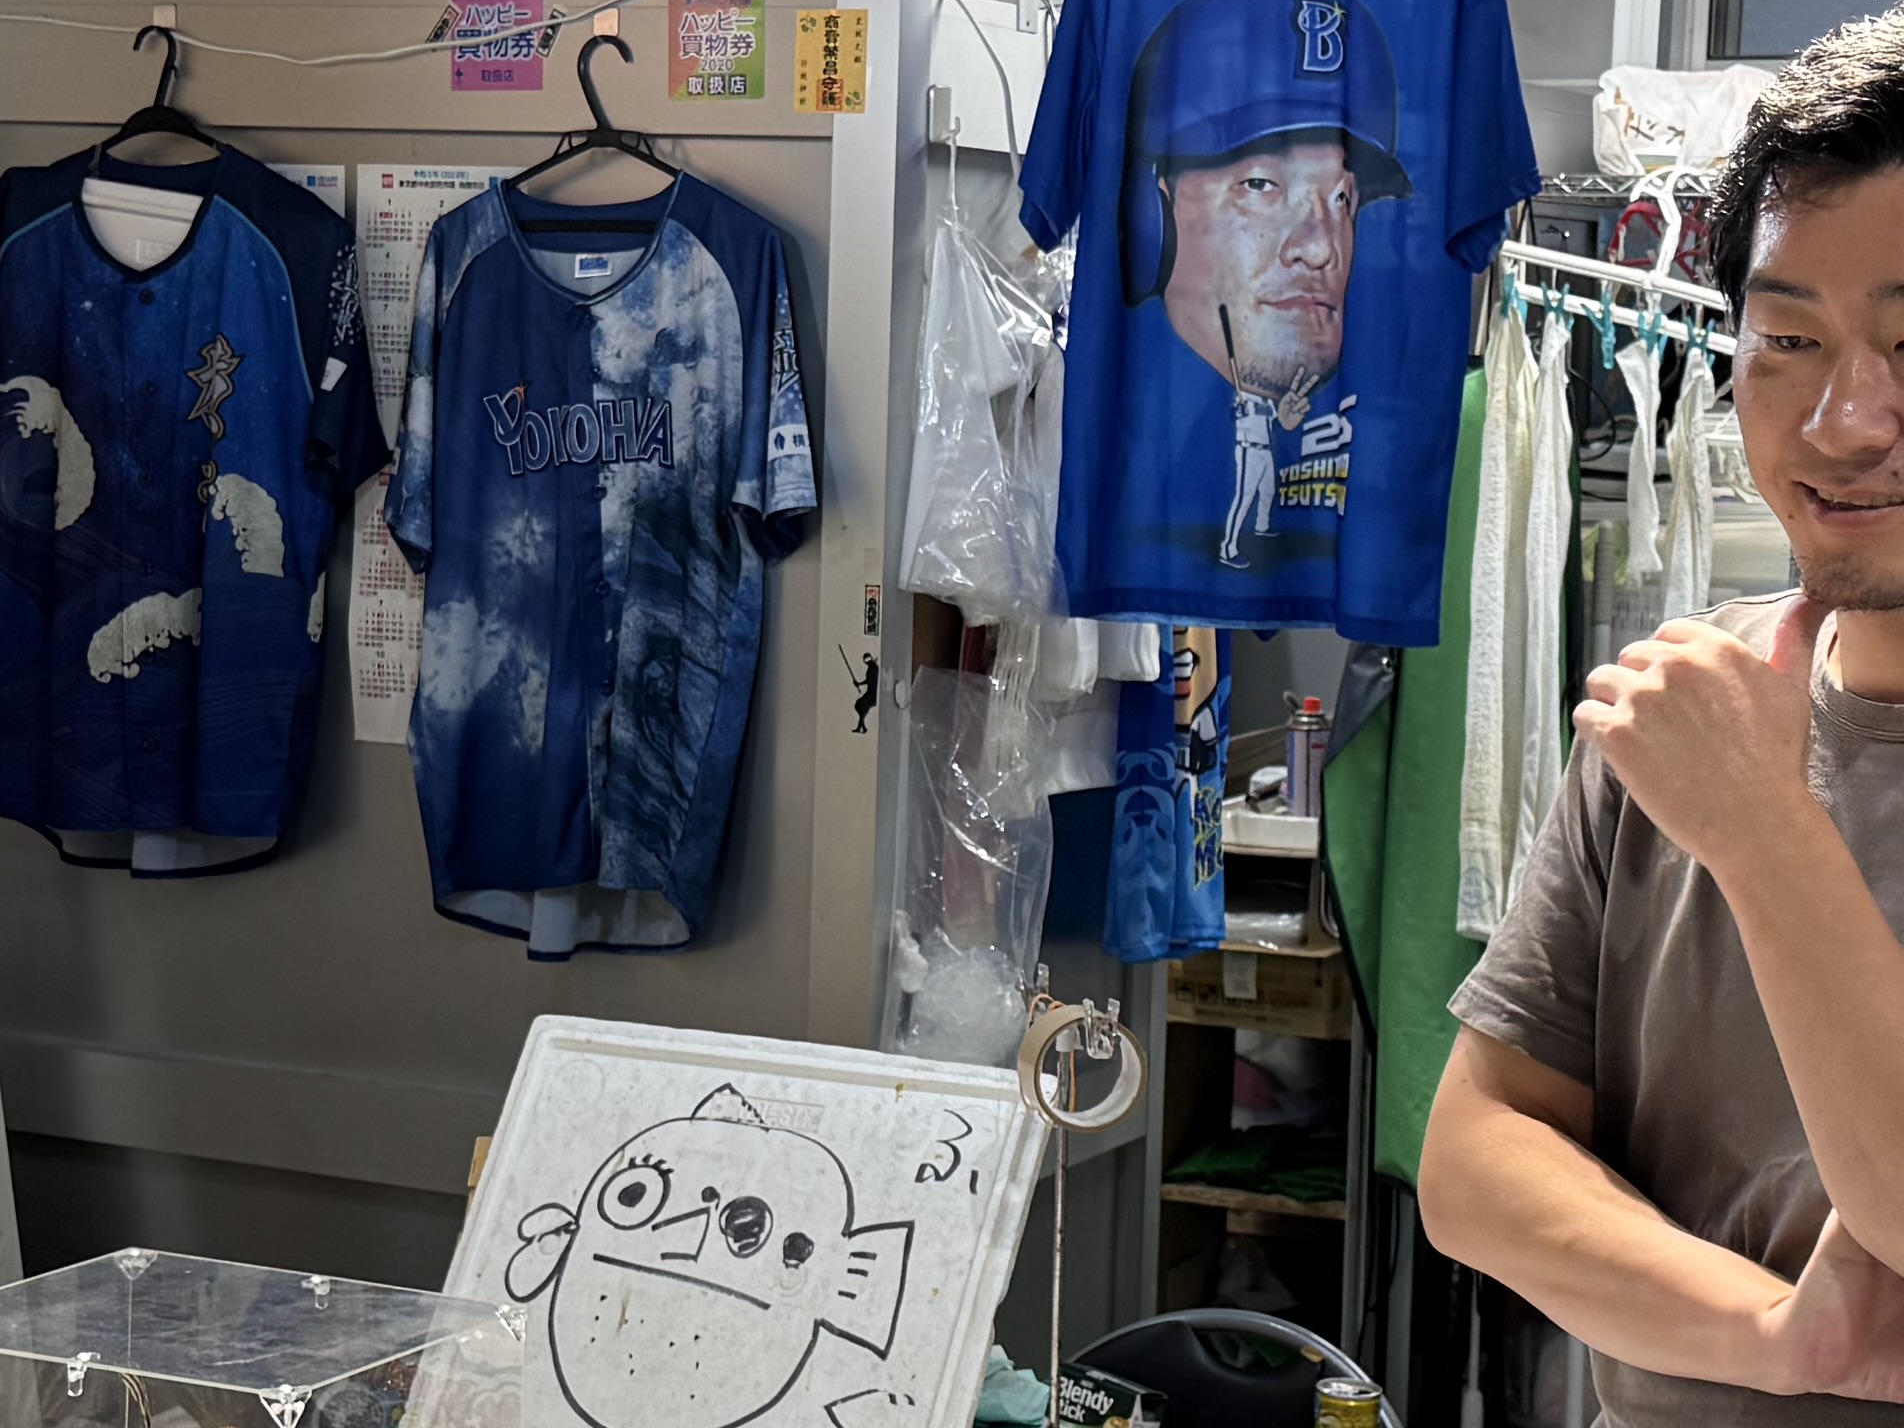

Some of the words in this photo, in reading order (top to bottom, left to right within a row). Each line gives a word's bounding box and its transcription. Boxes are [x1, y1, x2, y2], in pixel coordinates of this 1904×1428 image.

[465, 3, 529, 25] ハッピー
[680, 8, 754, 33] ハッピー
[455, 28, 536, 59] 買物券
[679, 34, 755, 58] 買物券
[701, 58, 735, 72] 2020
[688, 75, 747, 95] 取扱店
